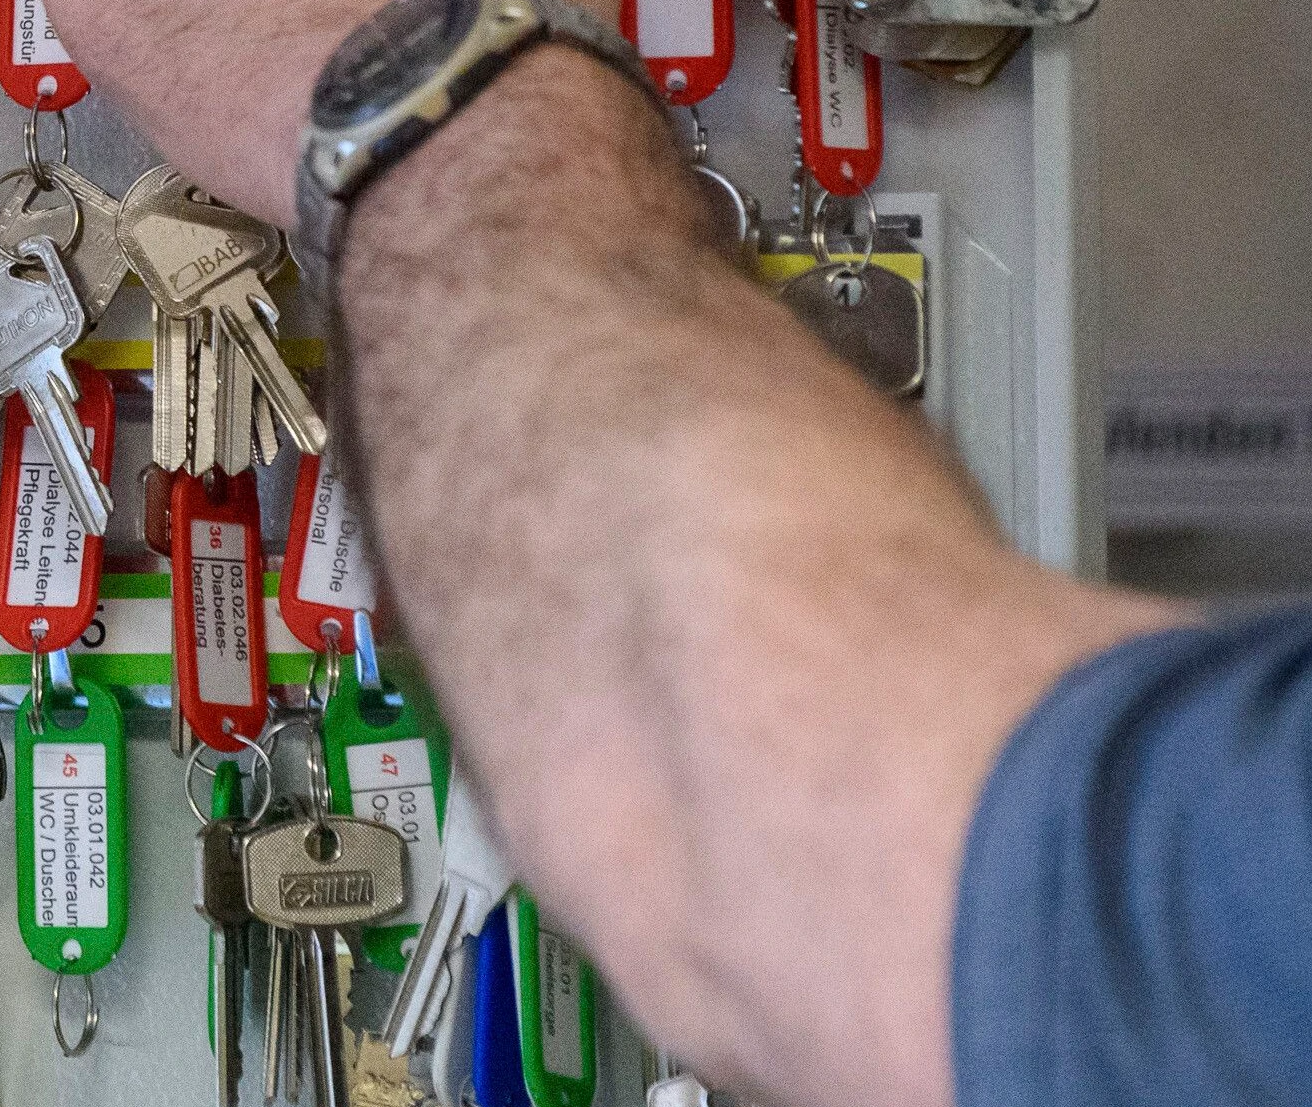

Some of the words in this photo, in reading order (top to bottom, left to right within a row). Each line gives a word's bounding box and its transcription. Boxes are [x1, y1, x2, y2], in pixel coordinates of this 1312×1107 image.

[823, 15, 841, 85] Dialyse
[828, 94, 844, 129] WC
[15, 470, 39, 570] Pflegekraft
[210, 525, 222, 548] 36
[191, 563, 208, 647] beratung
[210, 564, 225, 657] Diabetes-
[231, 565, 249, 660] 03.02.046
[63, 752, 77, 777] 45
[381, 753, 398, 776] 47
[39, 793, 56, 827] WC
[88, 792, 106, 889] 03.01.042
